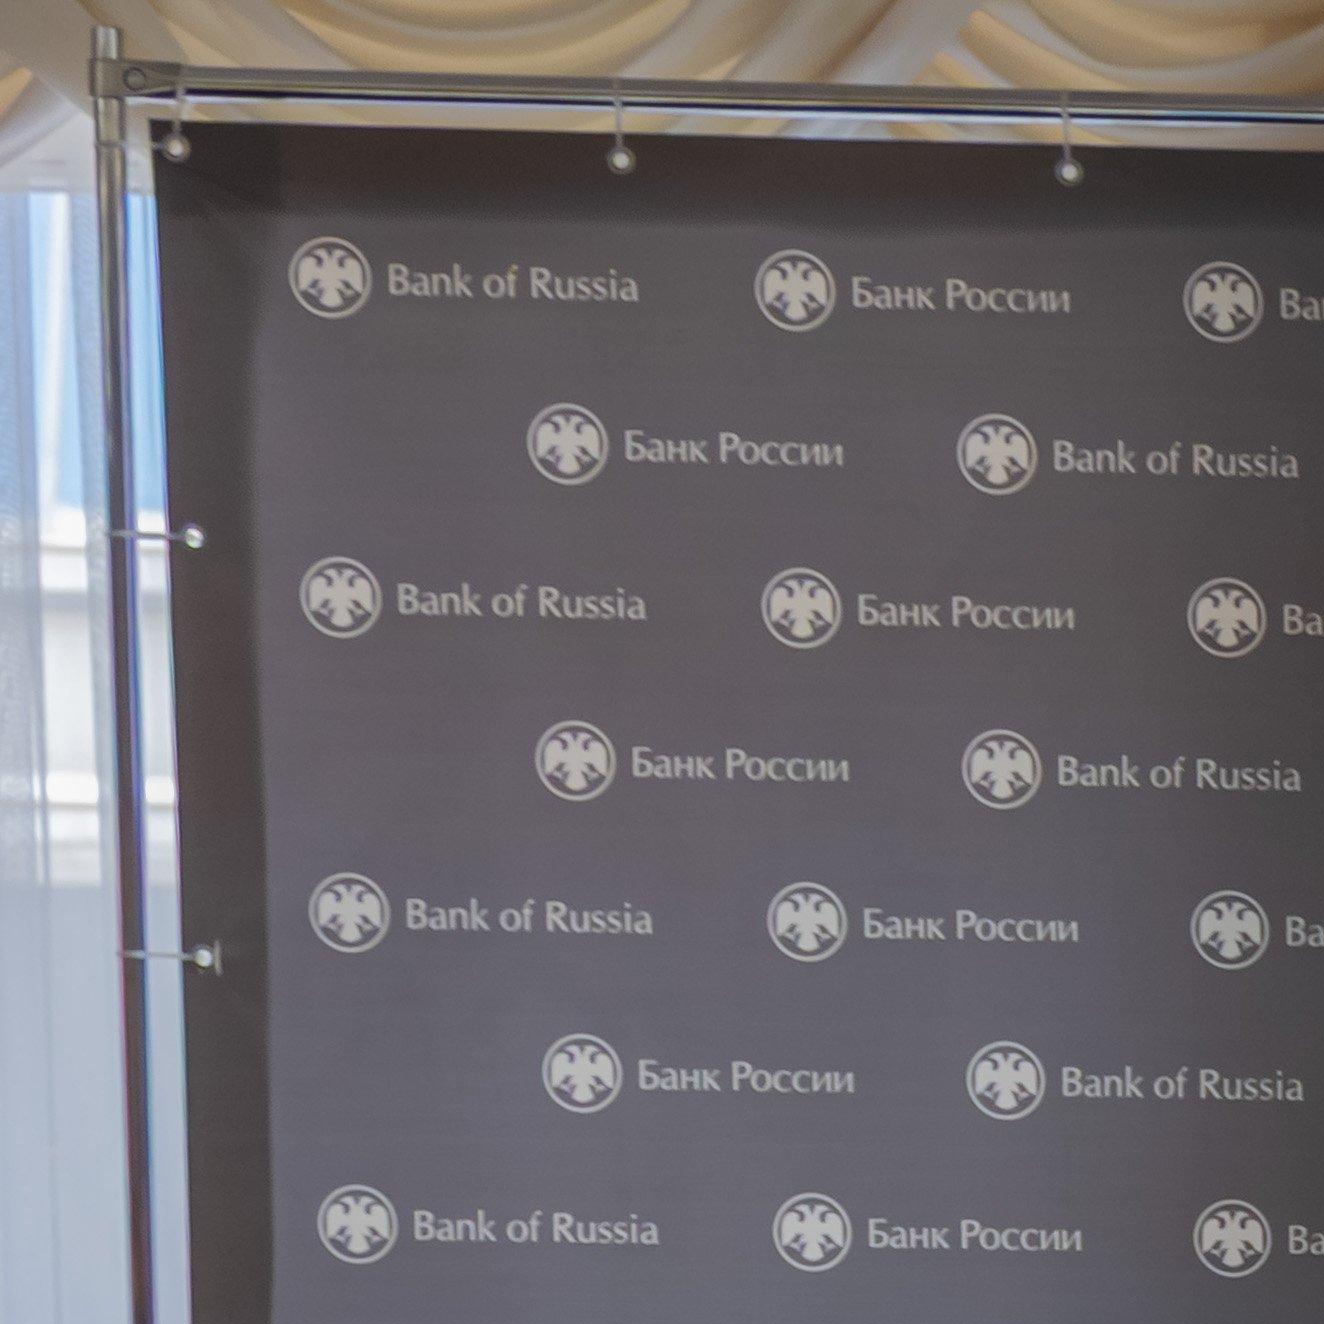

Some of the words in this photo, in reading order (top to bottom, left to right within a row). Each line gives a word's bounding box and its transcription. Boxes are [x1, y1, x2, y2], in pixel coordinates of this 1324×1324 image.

[387, 262, 473, 298] Bank
[482, 264, 519, 299] of
[529, 266, 639, 302] Russia
[851, 275, 936, 310] Банк
[945, 278, 1070, 313] России
[397, 582, 482, 616] Bank
[491, 583, 529, 618] of
[538, 585, 647, 620] Russia
[857, 593, 941, 627] Банк
[951, 595, 1075, 630] России
[1057, 754, 1140, 788] Bank
[1149, 755, 1186, 789] of
[1196, 758, 1301, 791] Russia
[637, 1058, 721, 1092] Банк
[731, 1060, 855, 1094] России
[413, 1209, 497, 1242] Bank
[506, 1209, 543, 1243] of
[552, 1211, 660, 1246] Russia
[867, 1217, 950, 1250] Банк
[960, 1218, 1082, 1252] России
